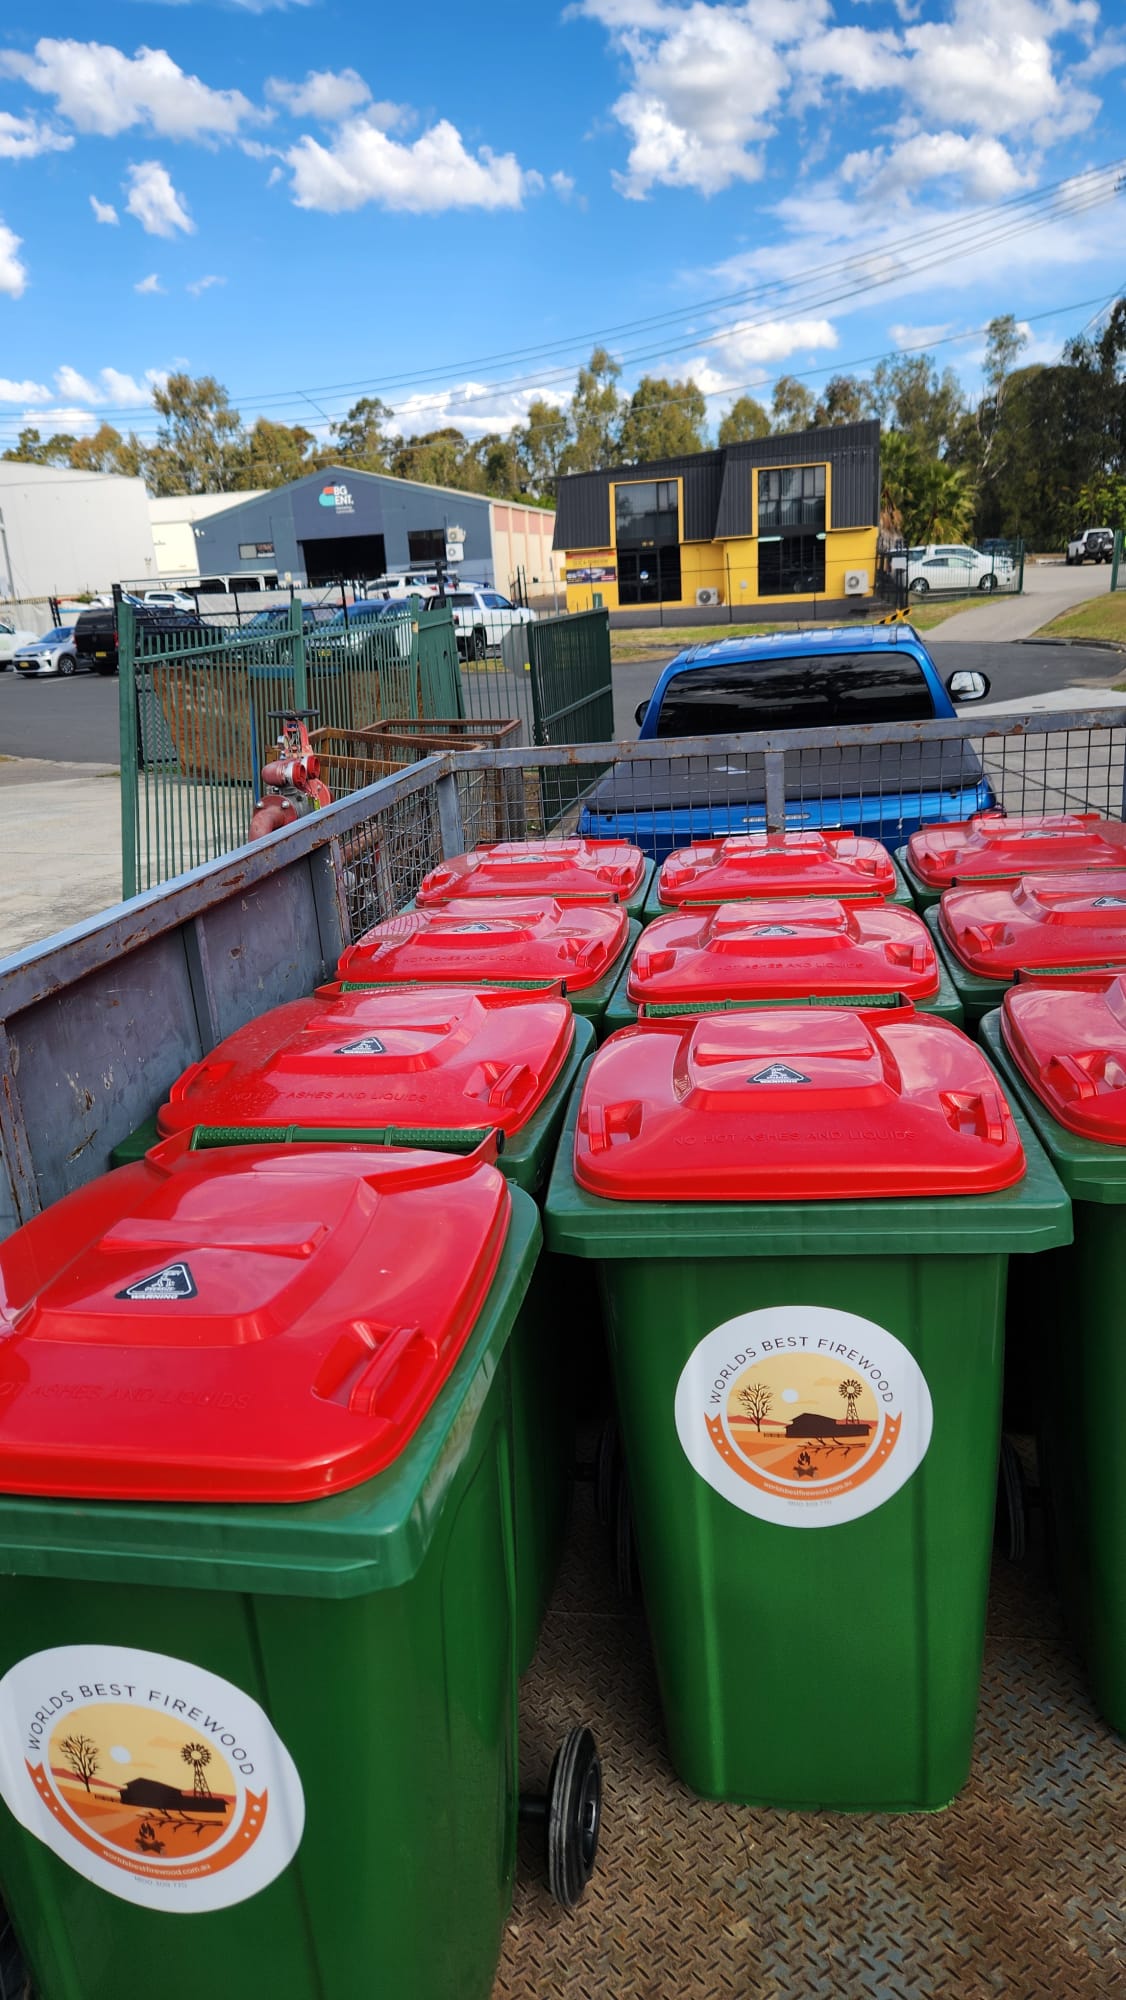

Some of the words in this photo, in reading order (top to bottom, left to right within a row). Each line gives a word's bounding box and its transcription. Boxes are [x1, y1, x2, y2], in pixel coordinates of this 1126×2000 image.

[334, 484, 348, 495] BG
[288, 1091, 333, 1101] ASHES
[337, 1091, 367, 1101] AND
[370, 1092, 428, 1103] LIQUIDS
[743, 1131, 801, 1143] ASHES
[807, 1129, 842, 1141] AND
[848, 1129, 918, 1142] LIQUIDS
[709, 1347, 757, 1405] WORLDS
[761, 1335, 809, 1352] BEST
[816, 1338, 894, 1404] FIREWOOD
[105, 1384, 154, 1402] AND
[26, 1689, 75, 1752] WORLDS
[78, 1683, 137, 1699] BEST
[147, 1689, 256, 1777] FIREWOOD
